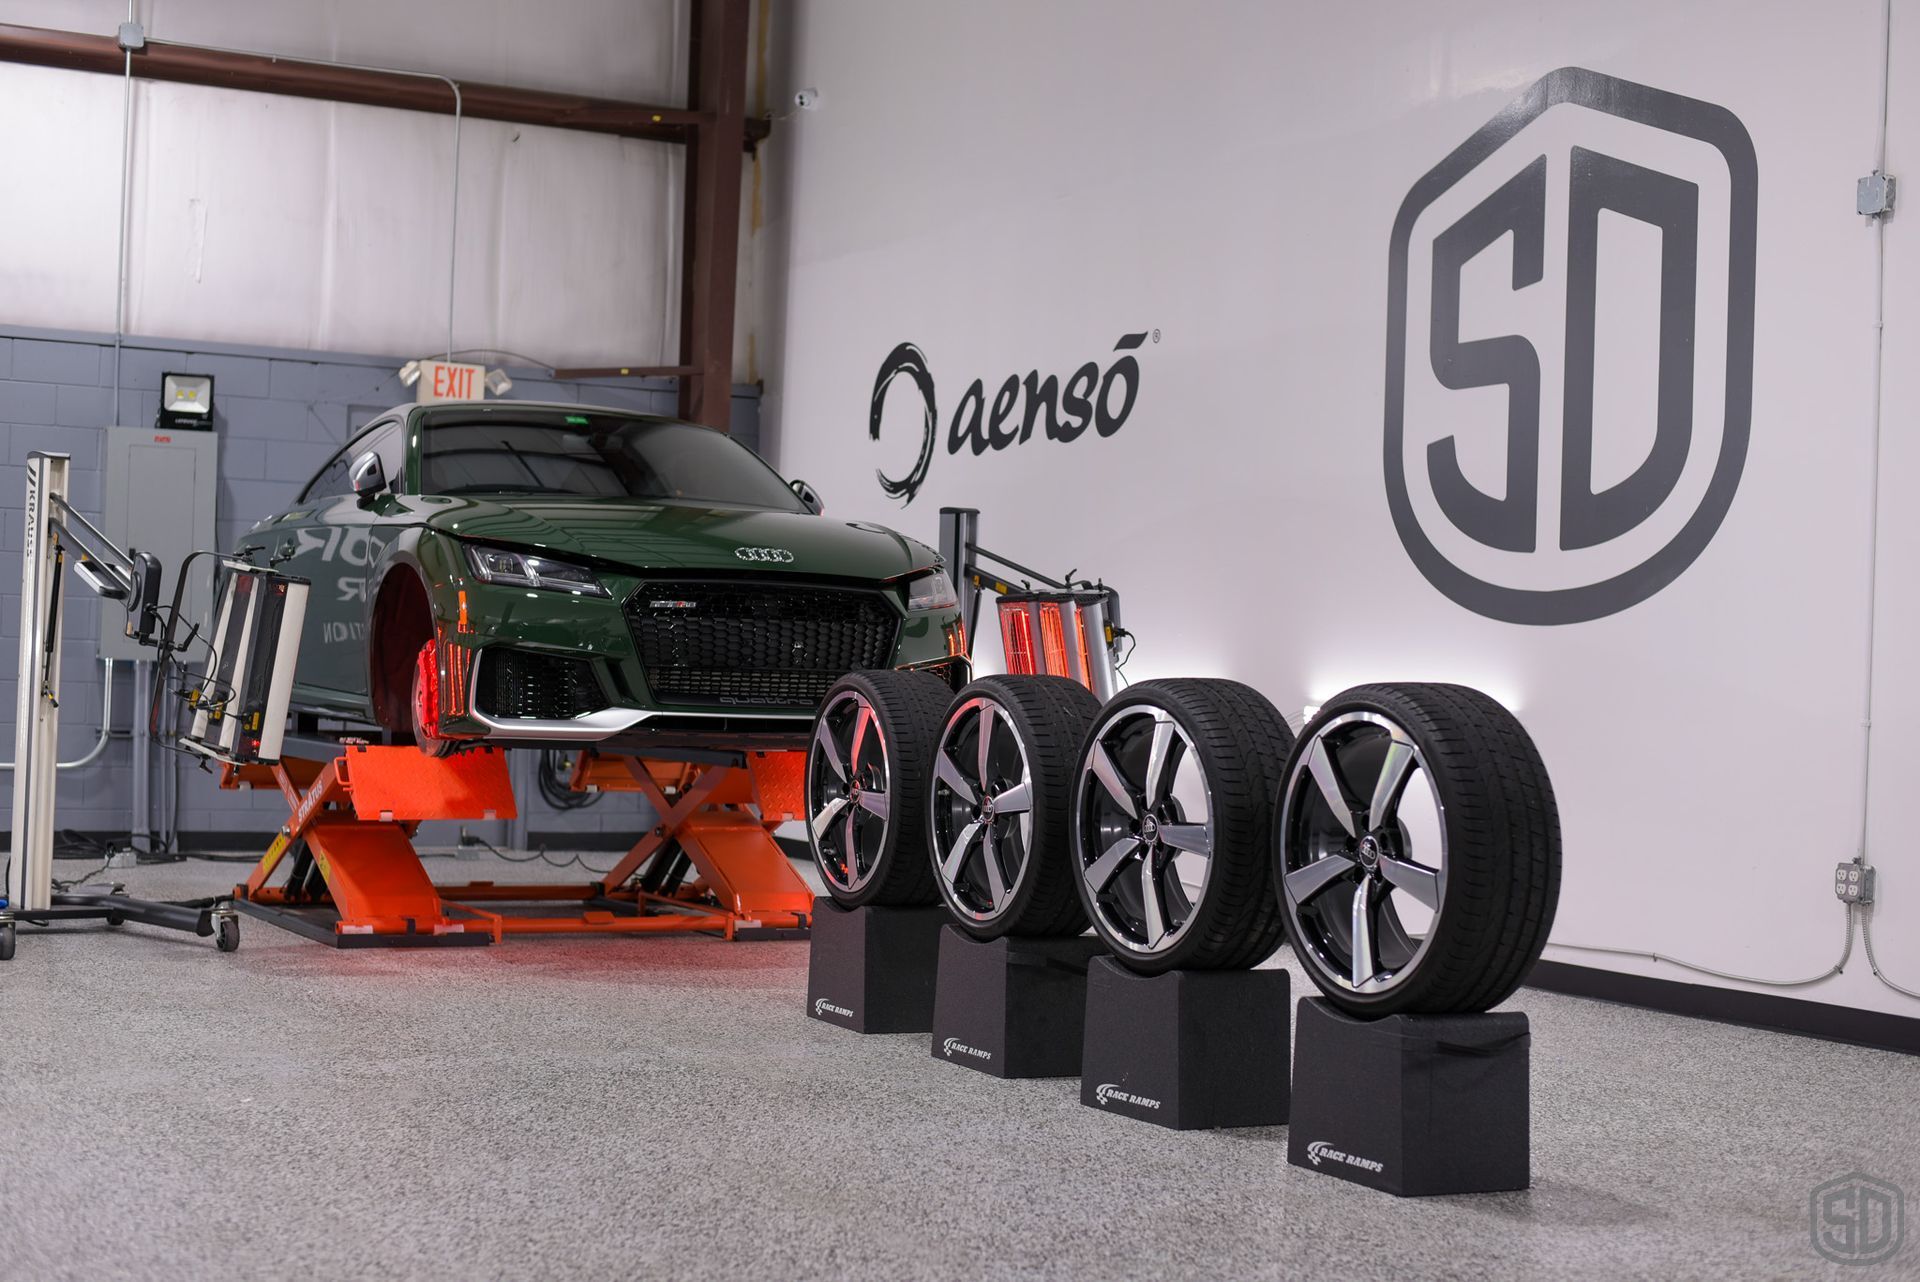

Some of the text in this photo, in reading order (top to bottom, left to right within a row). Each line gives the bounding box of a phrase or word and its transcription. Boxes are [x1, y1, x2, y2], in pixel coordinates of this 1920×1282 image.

[1427, 145, 1699, 553] SD
[433, 364, 475, 401] EXIT
[719, 696, 815, 706] quattro
[298, 780, 323, 823] STRATUS
[820, 1002, 854, 1018] RACE RAMPS
[950, 1041, 992, 1060] RACE RAMPS
[1106, 1089, 1161, 1109] RACE RAMPS
[1319, 1147, 1384, 1173] RACE RAMPS
